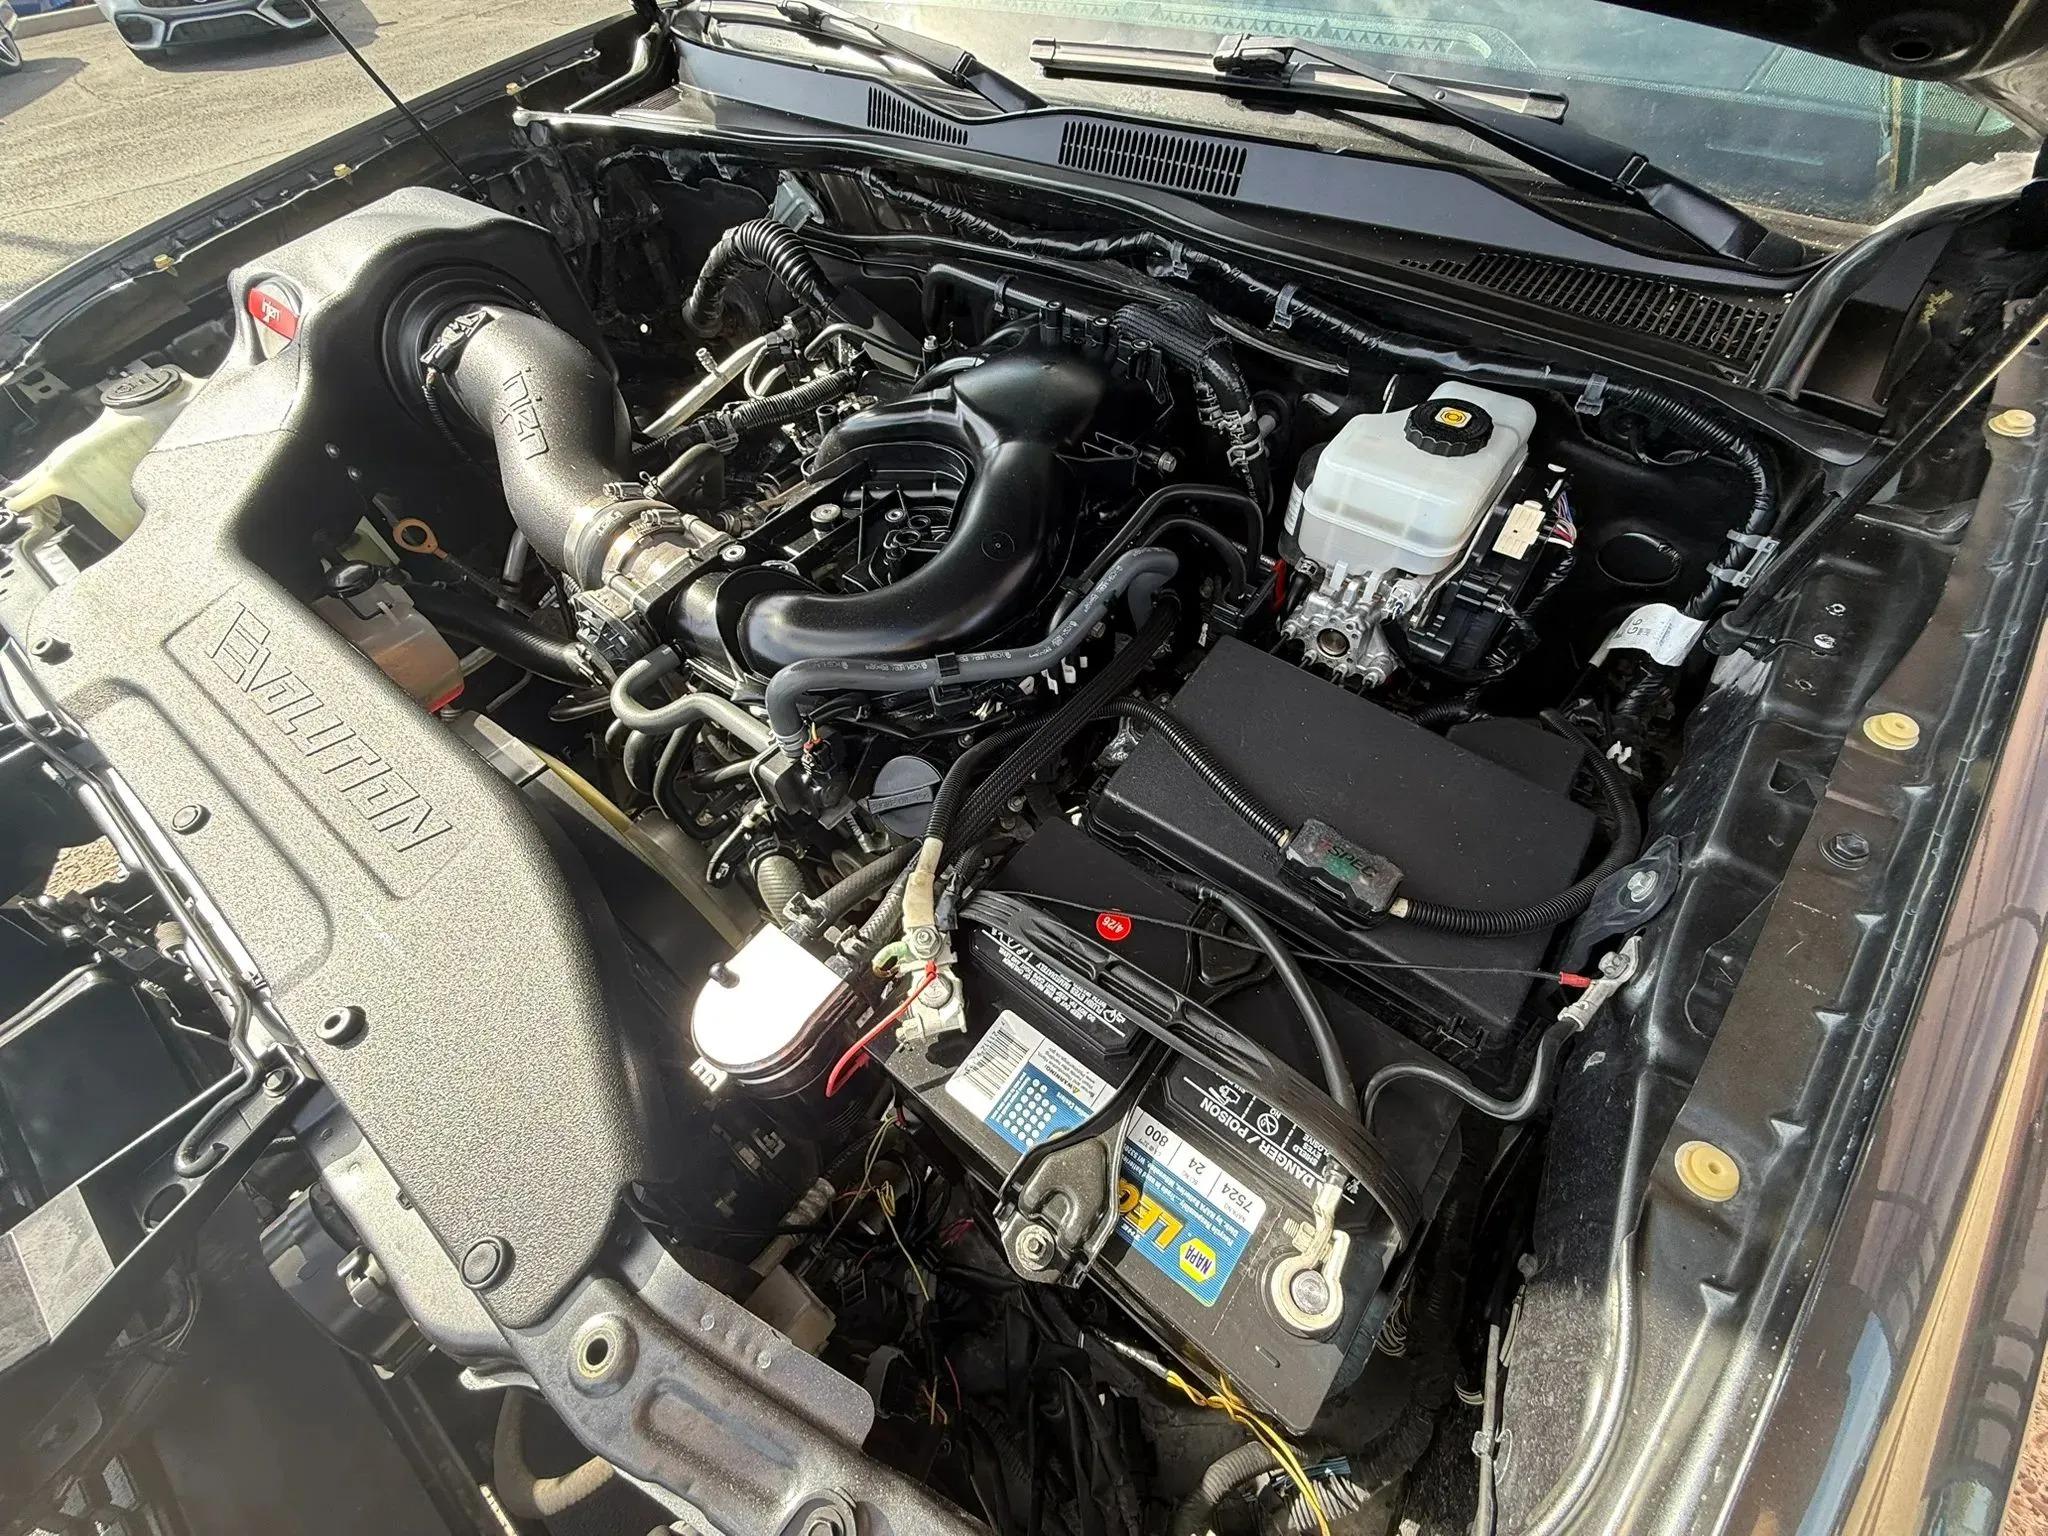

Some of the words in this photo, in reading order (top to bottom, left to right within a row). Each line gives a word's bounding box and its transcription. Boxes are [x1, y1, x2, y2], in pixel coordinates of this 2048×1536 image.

[202, 600, 453, 853] EVOLUTION
[1101, 916, 1123, 933] 4/26
[1198, 1096, 1250, 1138] POISON
[1143, 1123, 1170, 1147] 800
[1256, 1139, 1317, 1188] DANGER
[1290, 1143, 1319, 1166] SHIELD
[1301, 1141, 1322, 1159] EYES
[1185, 1156, 1206, 1175] 24
[1219, 1182, 1255, 1213] 7524
[1182, 1244, 1213, 1274] NAPA
